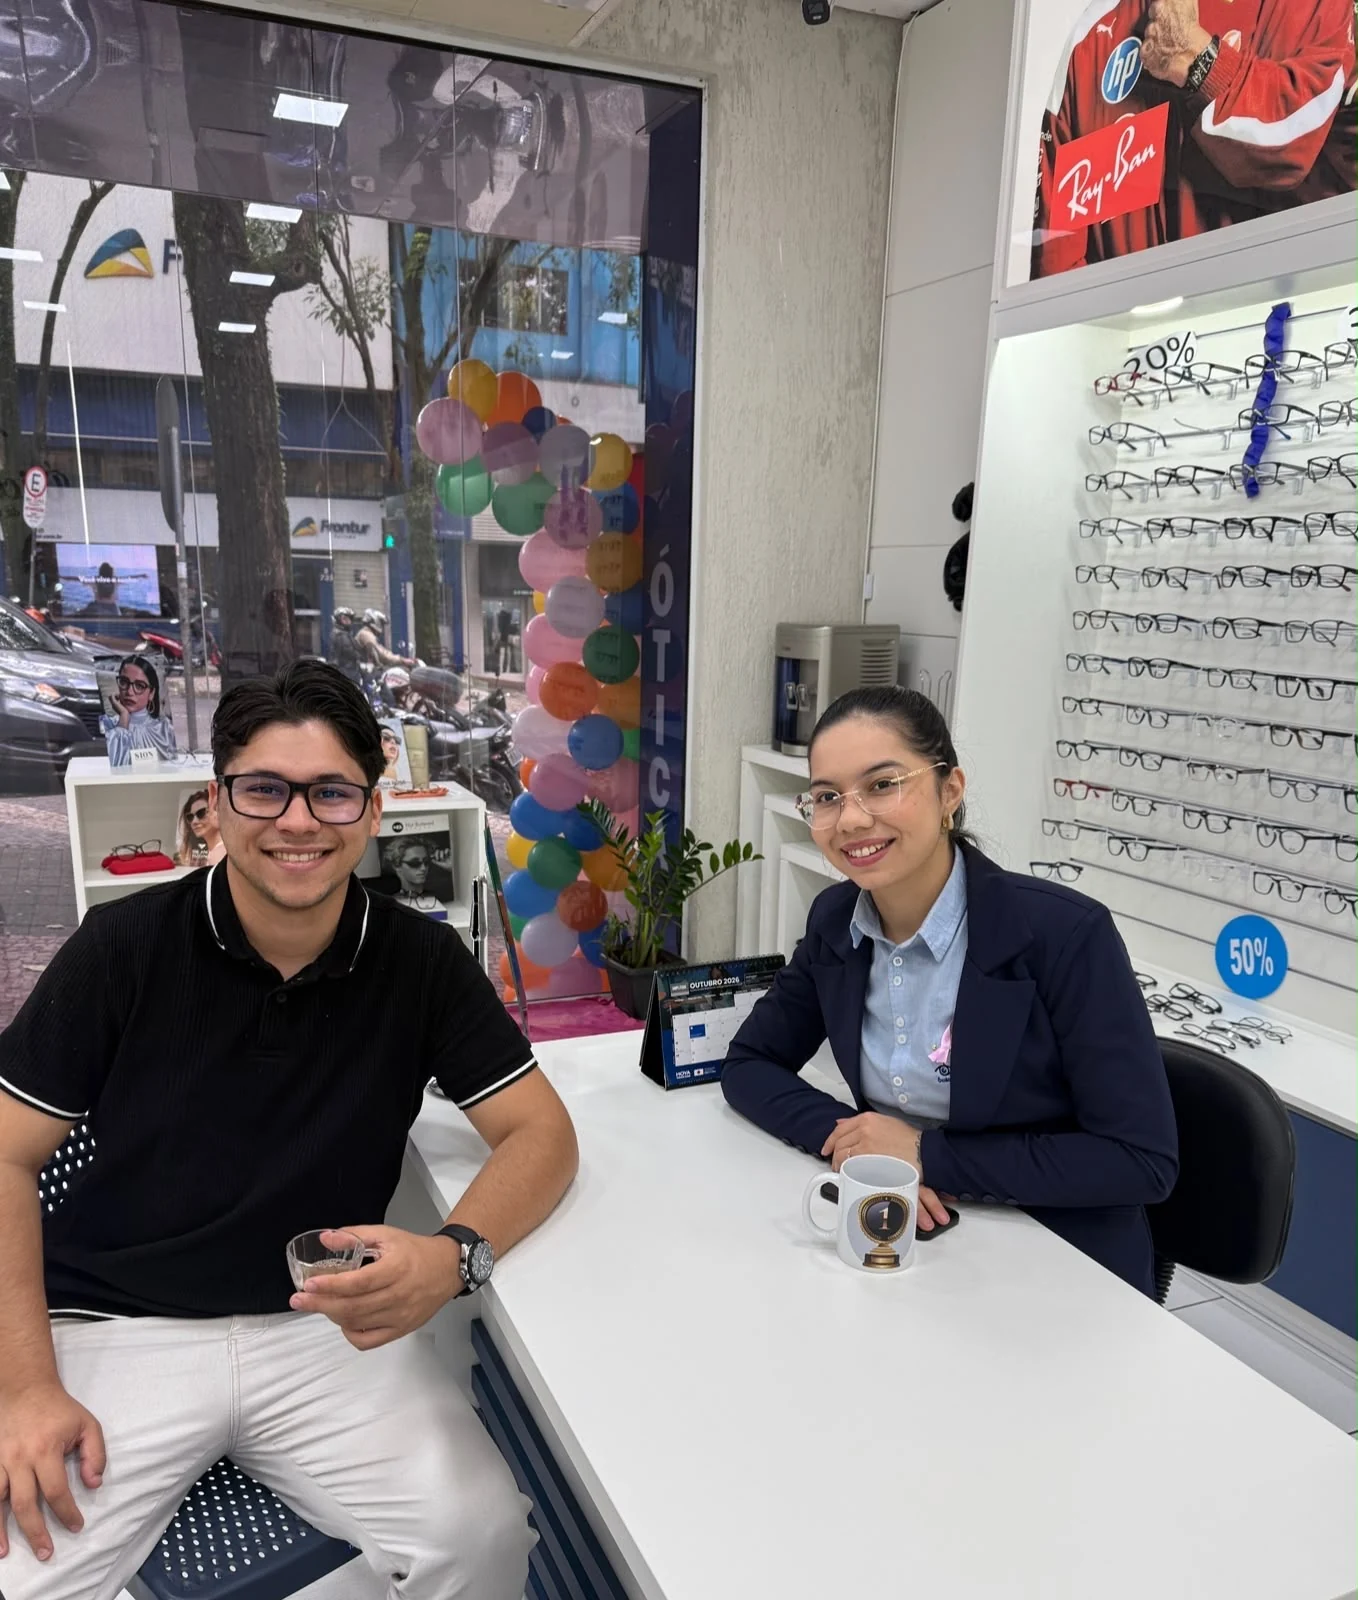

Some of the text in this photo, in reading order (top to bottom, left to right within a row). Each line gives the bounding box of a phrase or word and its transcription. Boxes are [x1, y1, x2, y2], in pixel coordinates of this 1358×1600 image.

[1107, 47, 1139, 101] hp
[1123, 331, 1195, 380] 20%
[31, 473, 42, 493] E
[320, 519, 370, 534] Frontur
[1229, 936, 1274, 977] 50%
[689, 978, 723, 989] OUTUBRO
[723, 976, 740, 986] 2026
[878, 1206, 891, 1231] 1
